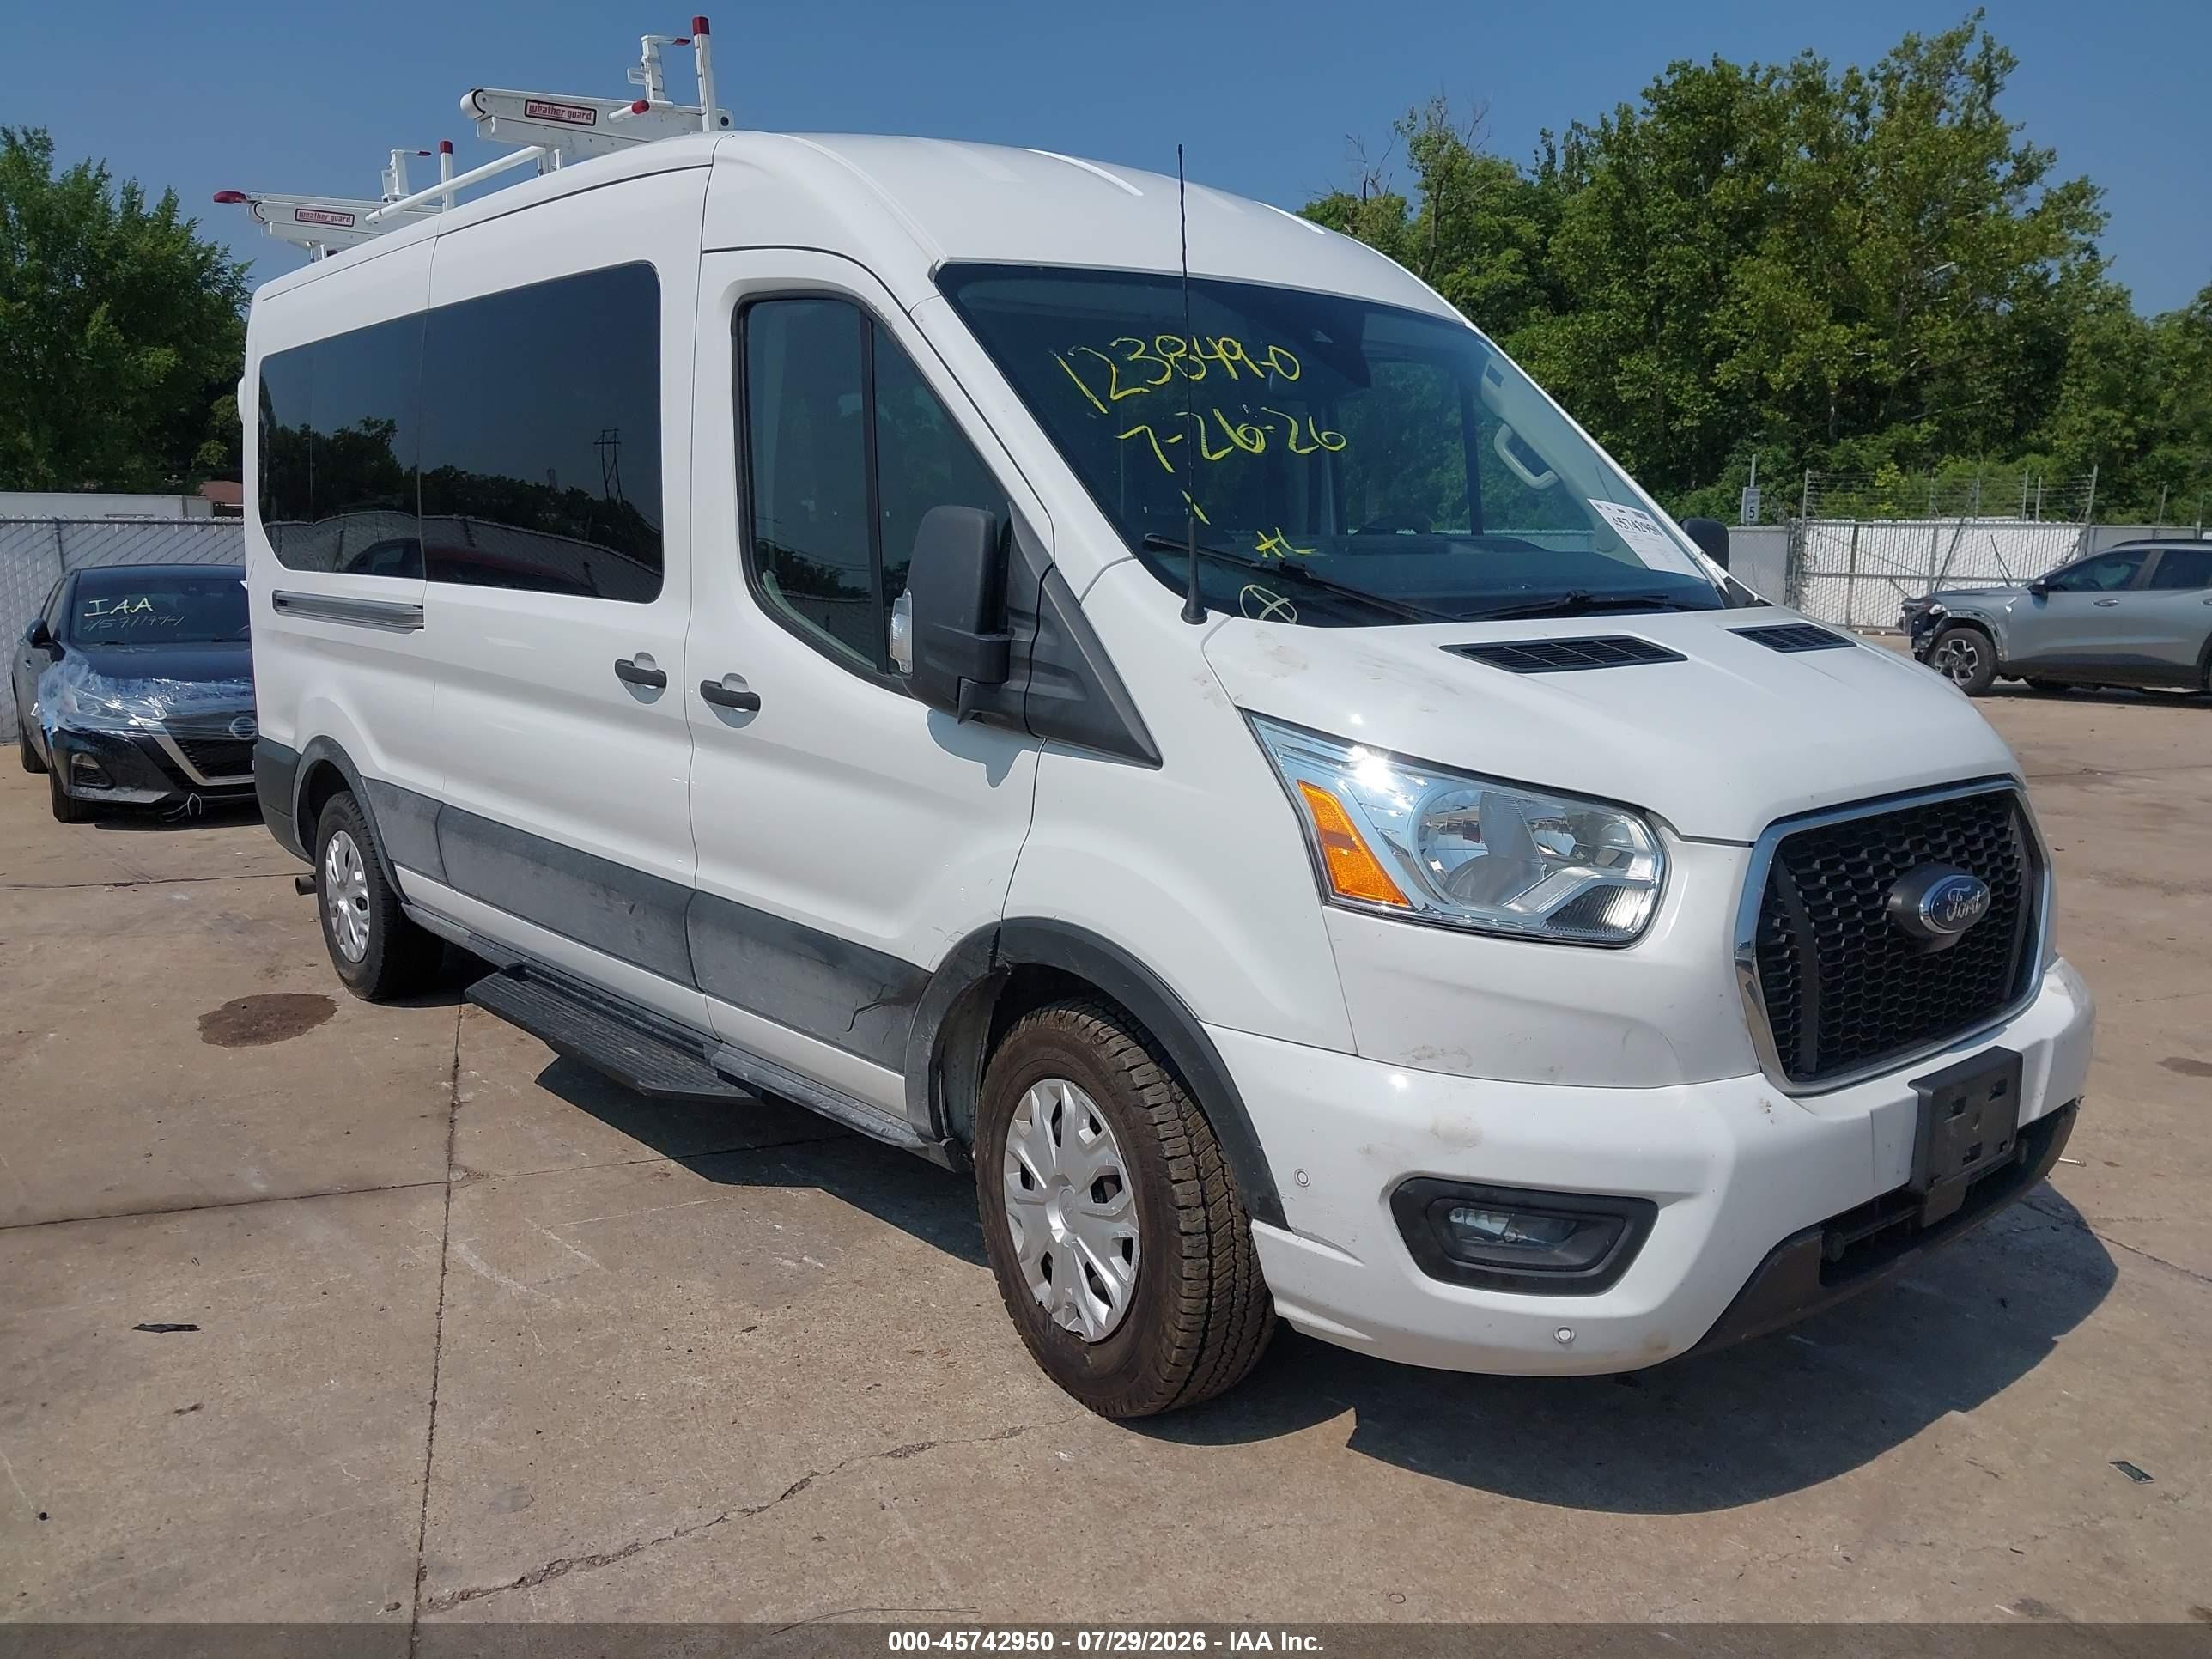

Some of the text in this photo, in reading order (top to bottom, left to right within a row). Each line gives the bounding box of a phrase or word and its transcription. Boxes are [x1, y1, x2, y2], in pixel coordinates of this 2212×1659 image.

[528, 103, 592, 120] weather guard
[330, 215, 351, 223] guard
[1748, 506, 1755, 519] 5
[83, 597, 155, 617] IAA
[1946, 885, 1984, 922] Ford
